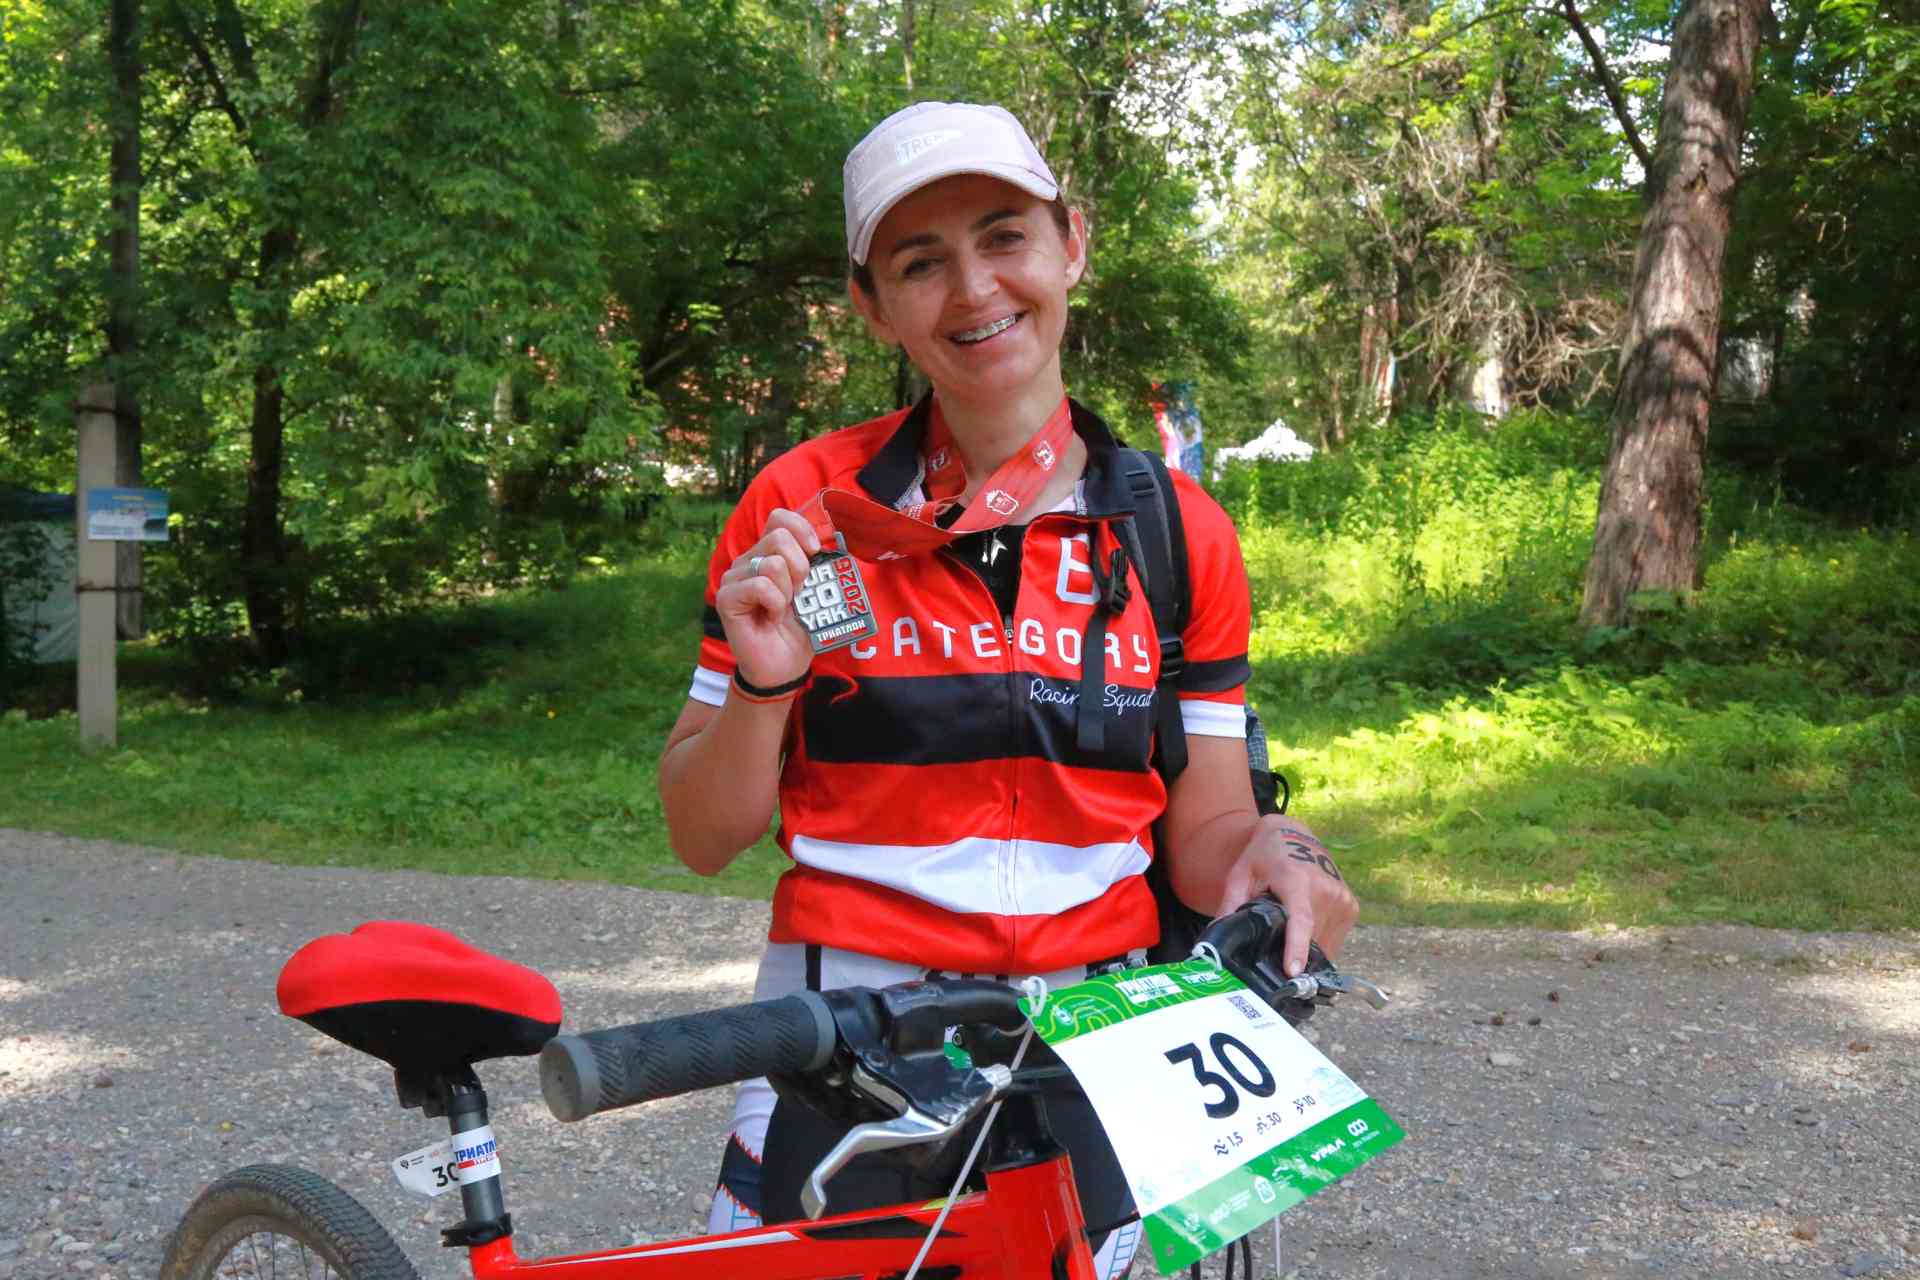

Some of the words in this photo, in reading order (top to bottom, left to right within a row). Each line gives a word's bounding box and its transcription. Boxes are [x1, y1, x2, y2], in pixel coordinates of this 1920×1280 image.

[1285, 841, 1341, 881] 30
[1163, 1032, 1277, 1119] 30
[1266, 1112, 1282, 1127] 30
[454, 1137, 497, 1161] ТРИАТЛ
